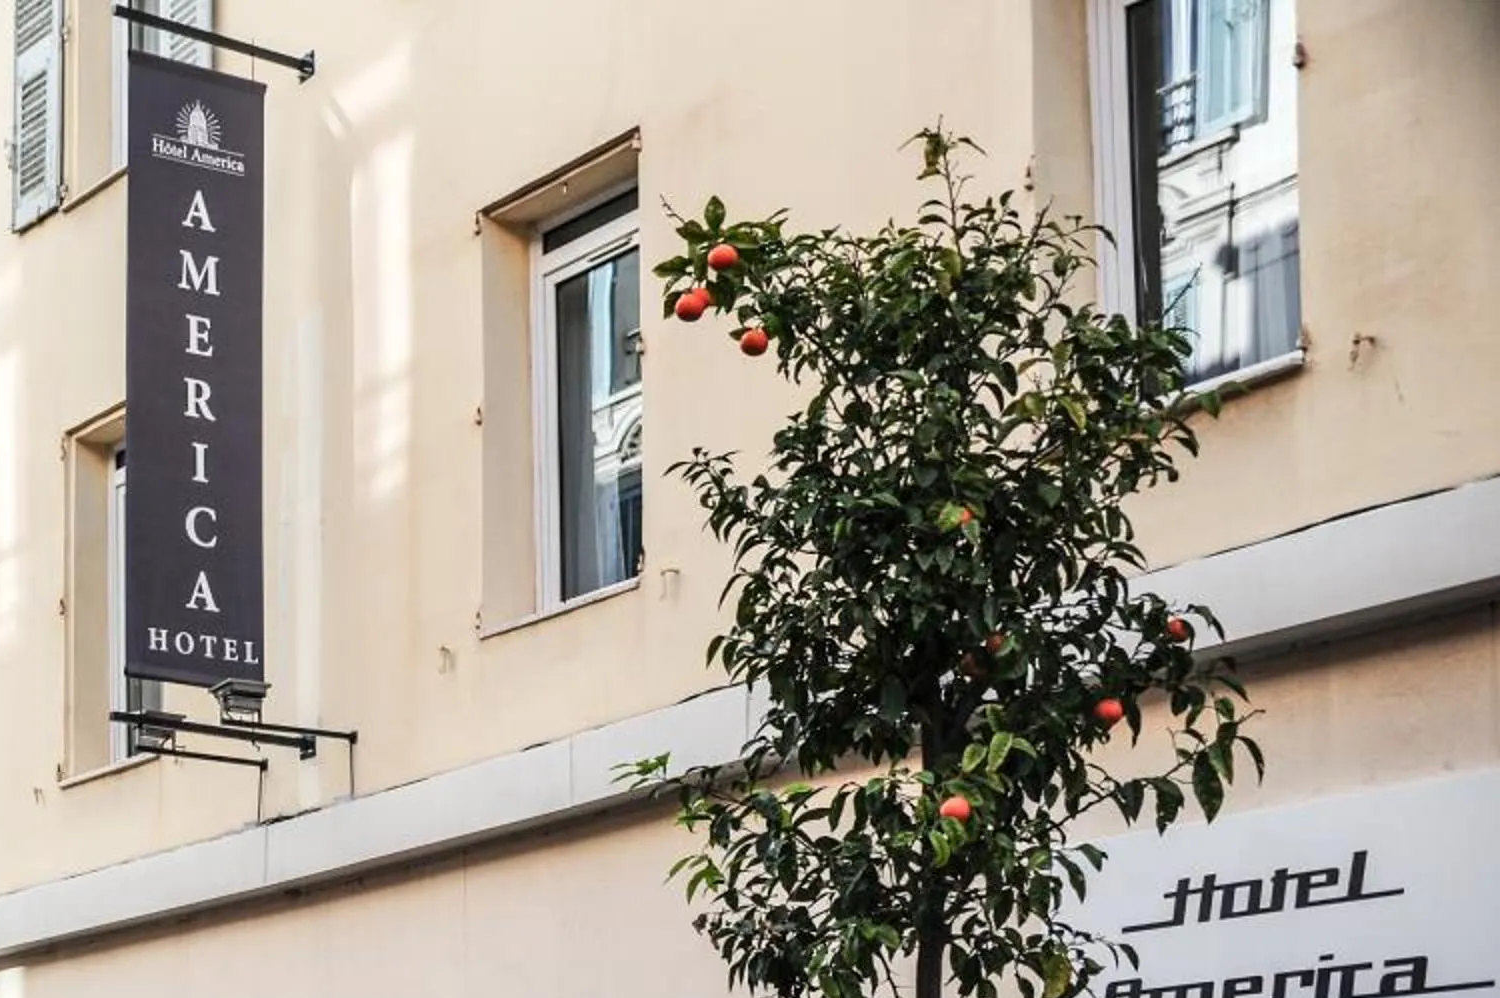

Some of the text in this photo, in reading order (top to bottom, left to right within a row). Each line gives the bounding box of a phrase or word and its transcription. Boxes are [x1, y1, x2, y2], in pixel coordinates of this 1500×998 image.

[191, 148, 245, 172] America
[178, 189, 221, 613] AMERICA
[148, 627, 259, 664] HOTEL
[1122, 850, 1404, 933] Hotel
